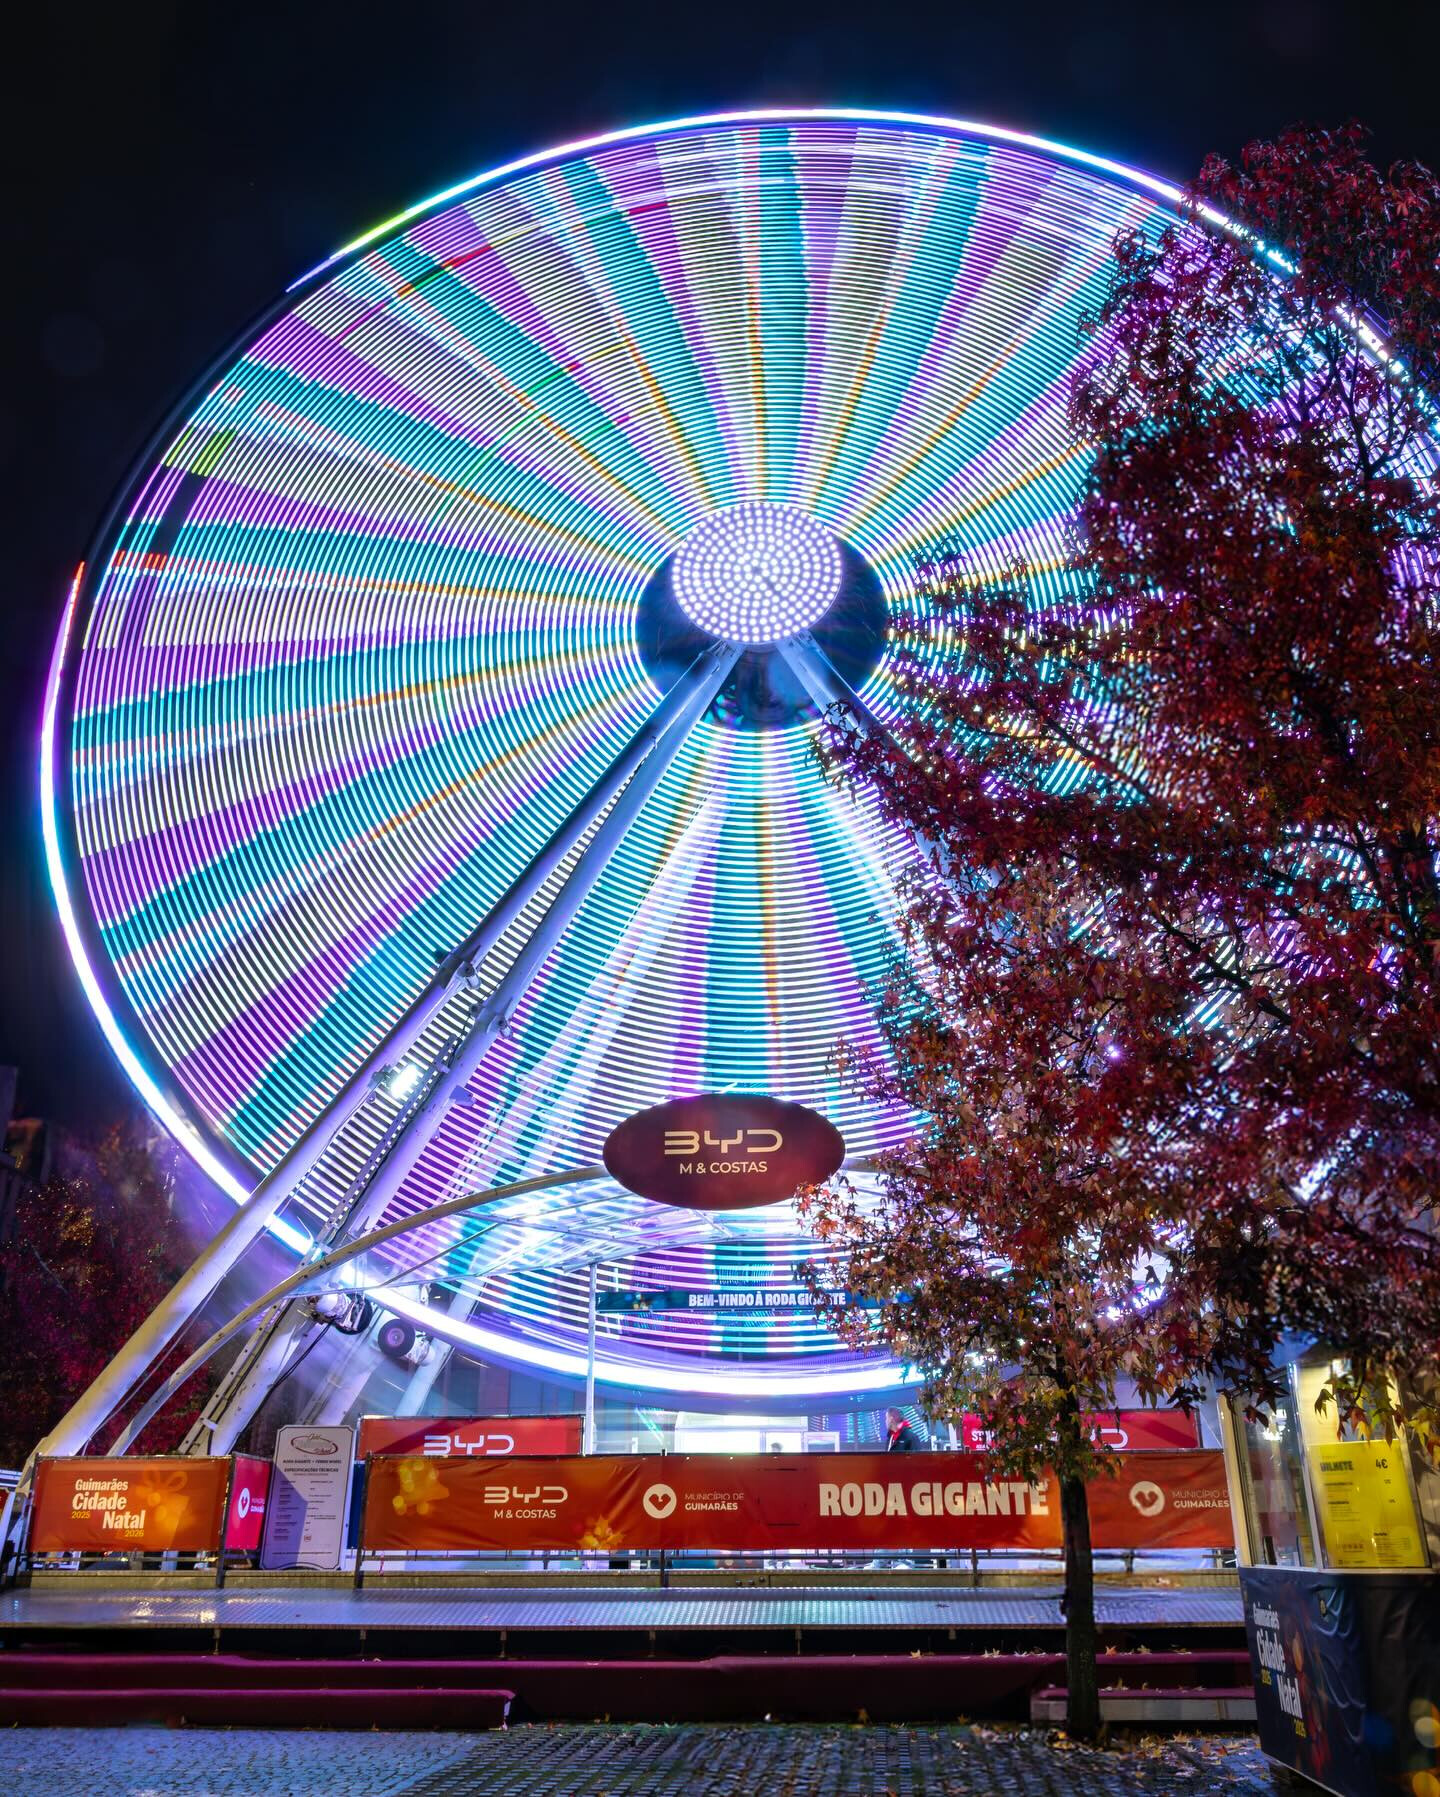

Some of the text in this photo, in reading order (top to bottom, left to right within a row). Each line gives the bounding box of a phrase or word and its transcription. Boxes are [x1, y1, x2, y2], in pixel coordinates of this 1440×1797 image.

[664, 1129, 783, 1155] BYD
[679, 1161, 768, 1174] M & COSTAS
[688, 1293, 754, 1307] BEM-VINDO
[755, 1291, 763, 1306] À
[765, 1293, 796, 1307] RODA
[423, 1434, 515, 1455] BYD
[1375, 1459, 1388, 1469] 4€
[75, 1478, 129, 1491] Guimarães
[484, 1486, 568, 1504] BYD
[684, 1491, 731, 1501] MUNICÍPIO
[819, 1481, 1049, 1516] RODA GIGANTE
[1172, 1488, 1220, 1498] MUNICÍPIO
[72, 1491, 127, 1510] Cidade
[685, 1501, 738, 1511] GUIMARÃES
[1173, 1499, 1230, 1509] GUIMARÃES
[71, 1511, 90, 1519] 2025
[102, 1510, 146, 1529] Natal
[494, 1510, 557, 1518] M & COSTAS
[124, 1529, 144, 1537] 2026
[1257, 1629, 1286, 1674] Cidade
[1277, 1674, 1302, 1719] Natal
